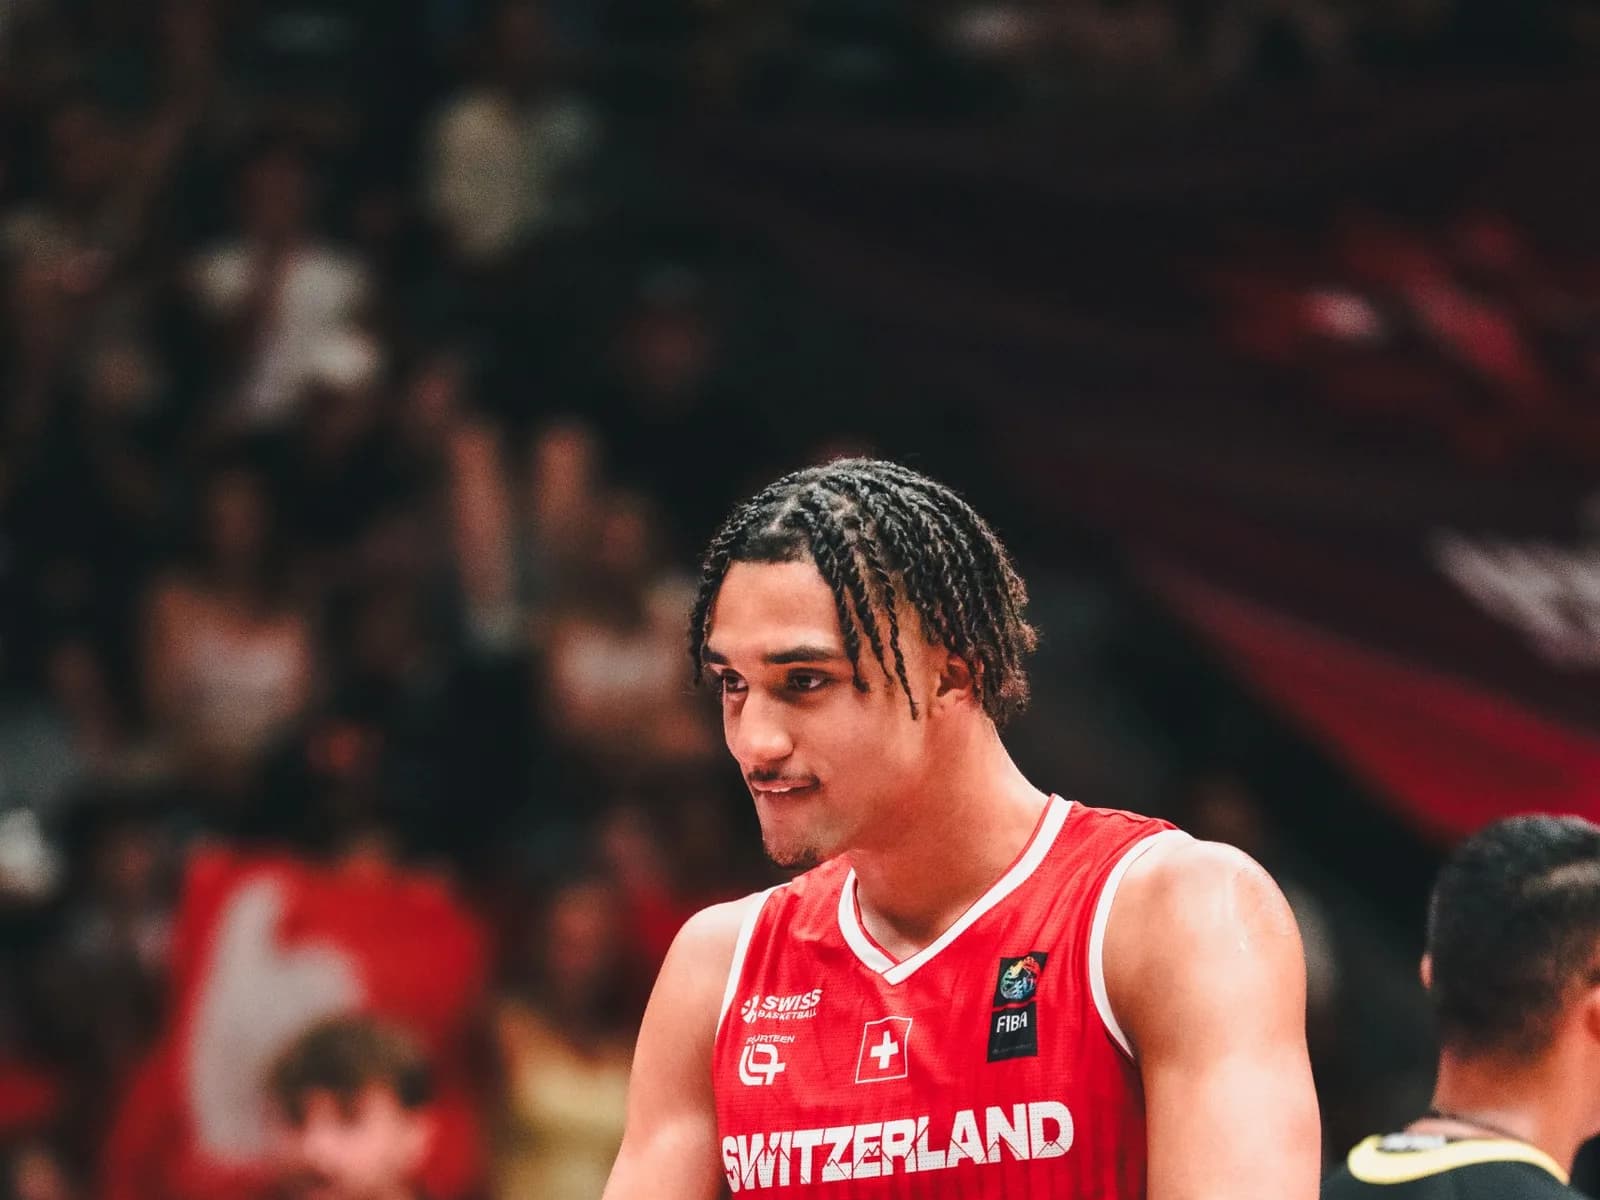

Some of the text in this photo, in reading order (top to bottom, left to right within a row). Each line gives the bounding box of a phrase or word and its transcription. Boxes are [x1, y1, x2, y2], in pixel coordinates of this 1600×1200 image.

[761, 988, 823, 1012] SWISS
[757, 1008, 817, 1021] BASKETBALL
[996, 1010, 1028, 1033] FIBA
[722, 1101, 1074, 1193] SWITZERLAND
